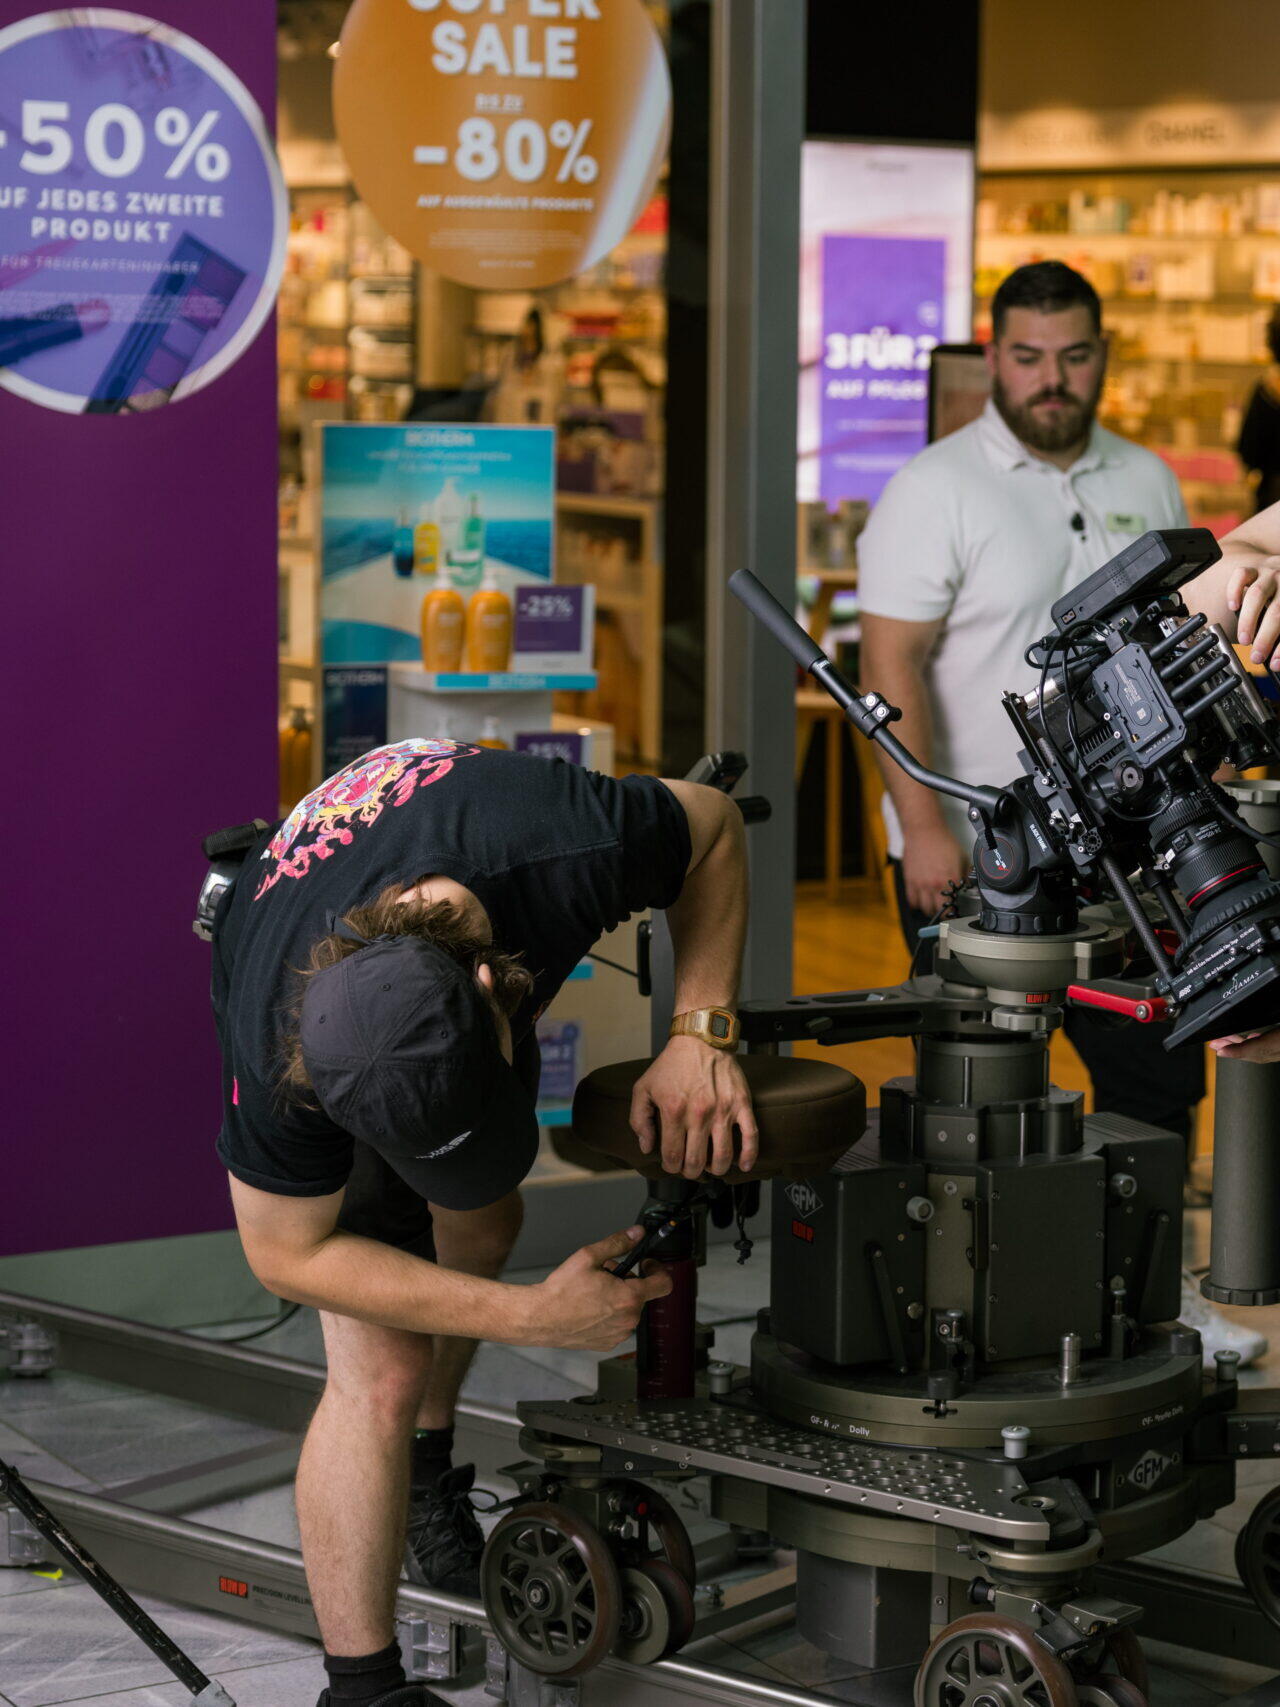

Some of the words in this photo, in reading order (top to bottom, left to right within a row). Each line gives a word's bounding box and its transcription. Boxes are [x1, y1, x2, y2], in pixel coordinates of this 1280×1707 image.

[432, 20, 578, 79] SALE
[413, 116, 599, 184] -80%
[36, 187, 118, 213] JEDES
[125, 190, 224, 218] ZWEITE
[30, 215, 173, 243] PRODUKT
[790, 1184, 817, 1212] GFM
[848, 1424, 871, 1438] Dolly
[1133, 1452, 1166, 1486] GFM
